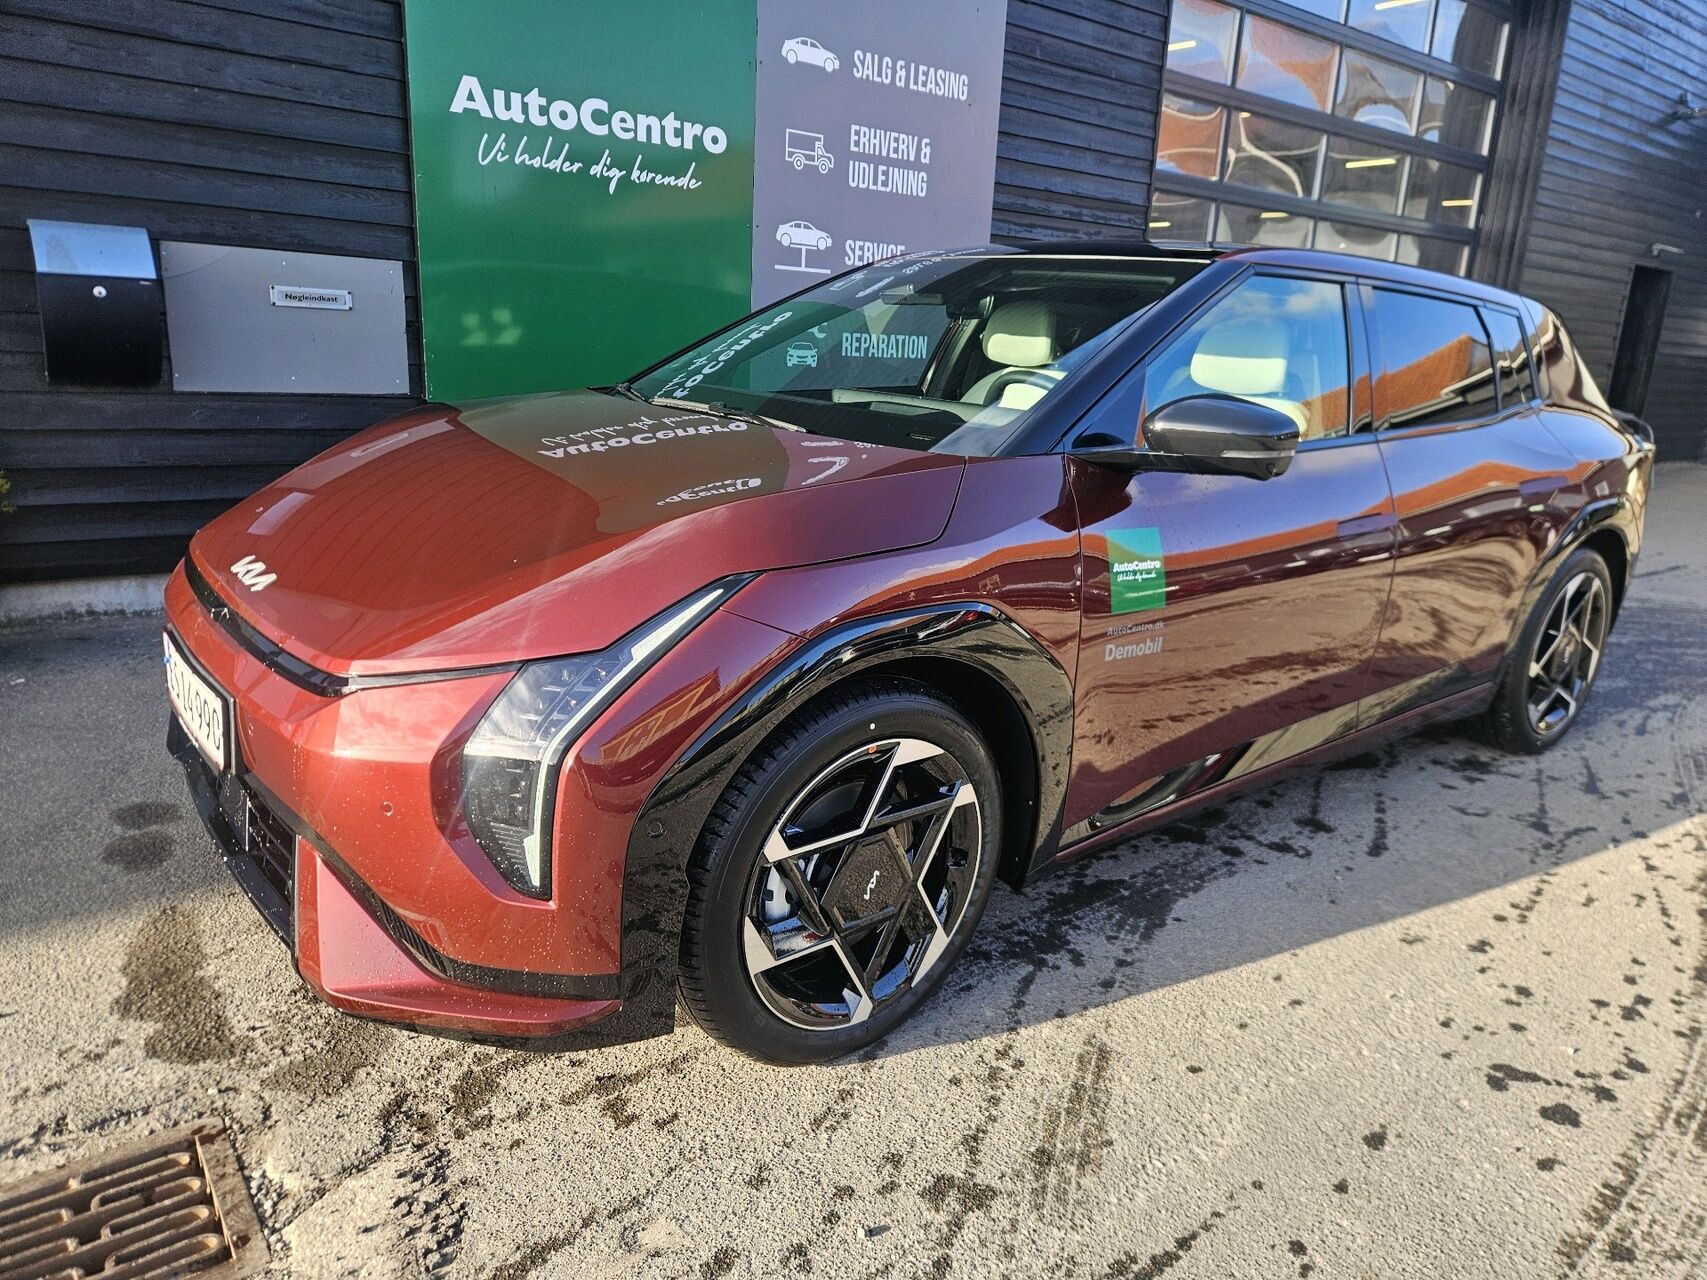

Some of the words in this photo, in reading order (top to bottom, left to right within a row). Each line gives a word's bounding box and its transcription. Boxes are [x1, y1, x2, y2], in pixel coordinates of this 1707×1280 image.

[853, 49, 892, 85] SALG
[895, 59, 906, 88] &
[909, 62, 968, 101] LEASING
[449, 75, 727, 154] AutoCentro
[850, 124, 918, 161] ERHVERV
[920, 138, 931, 164] &
[478, 133, 509, 165] Vi
[514, 136, 583, 174] holder
[589, 149, 626, 195] dig
[848, 160, 927, 197] UDLEJNING
[285, 293, 338, 302] Nøgleindkast
[842, 332, 928, 359] REPARATION
[1112, 560, 1161, 573] AutoCentro
[1107, 621, 1165, 636] AutoCentro.dk
[1104, 637, 1163, 662] Demobil
